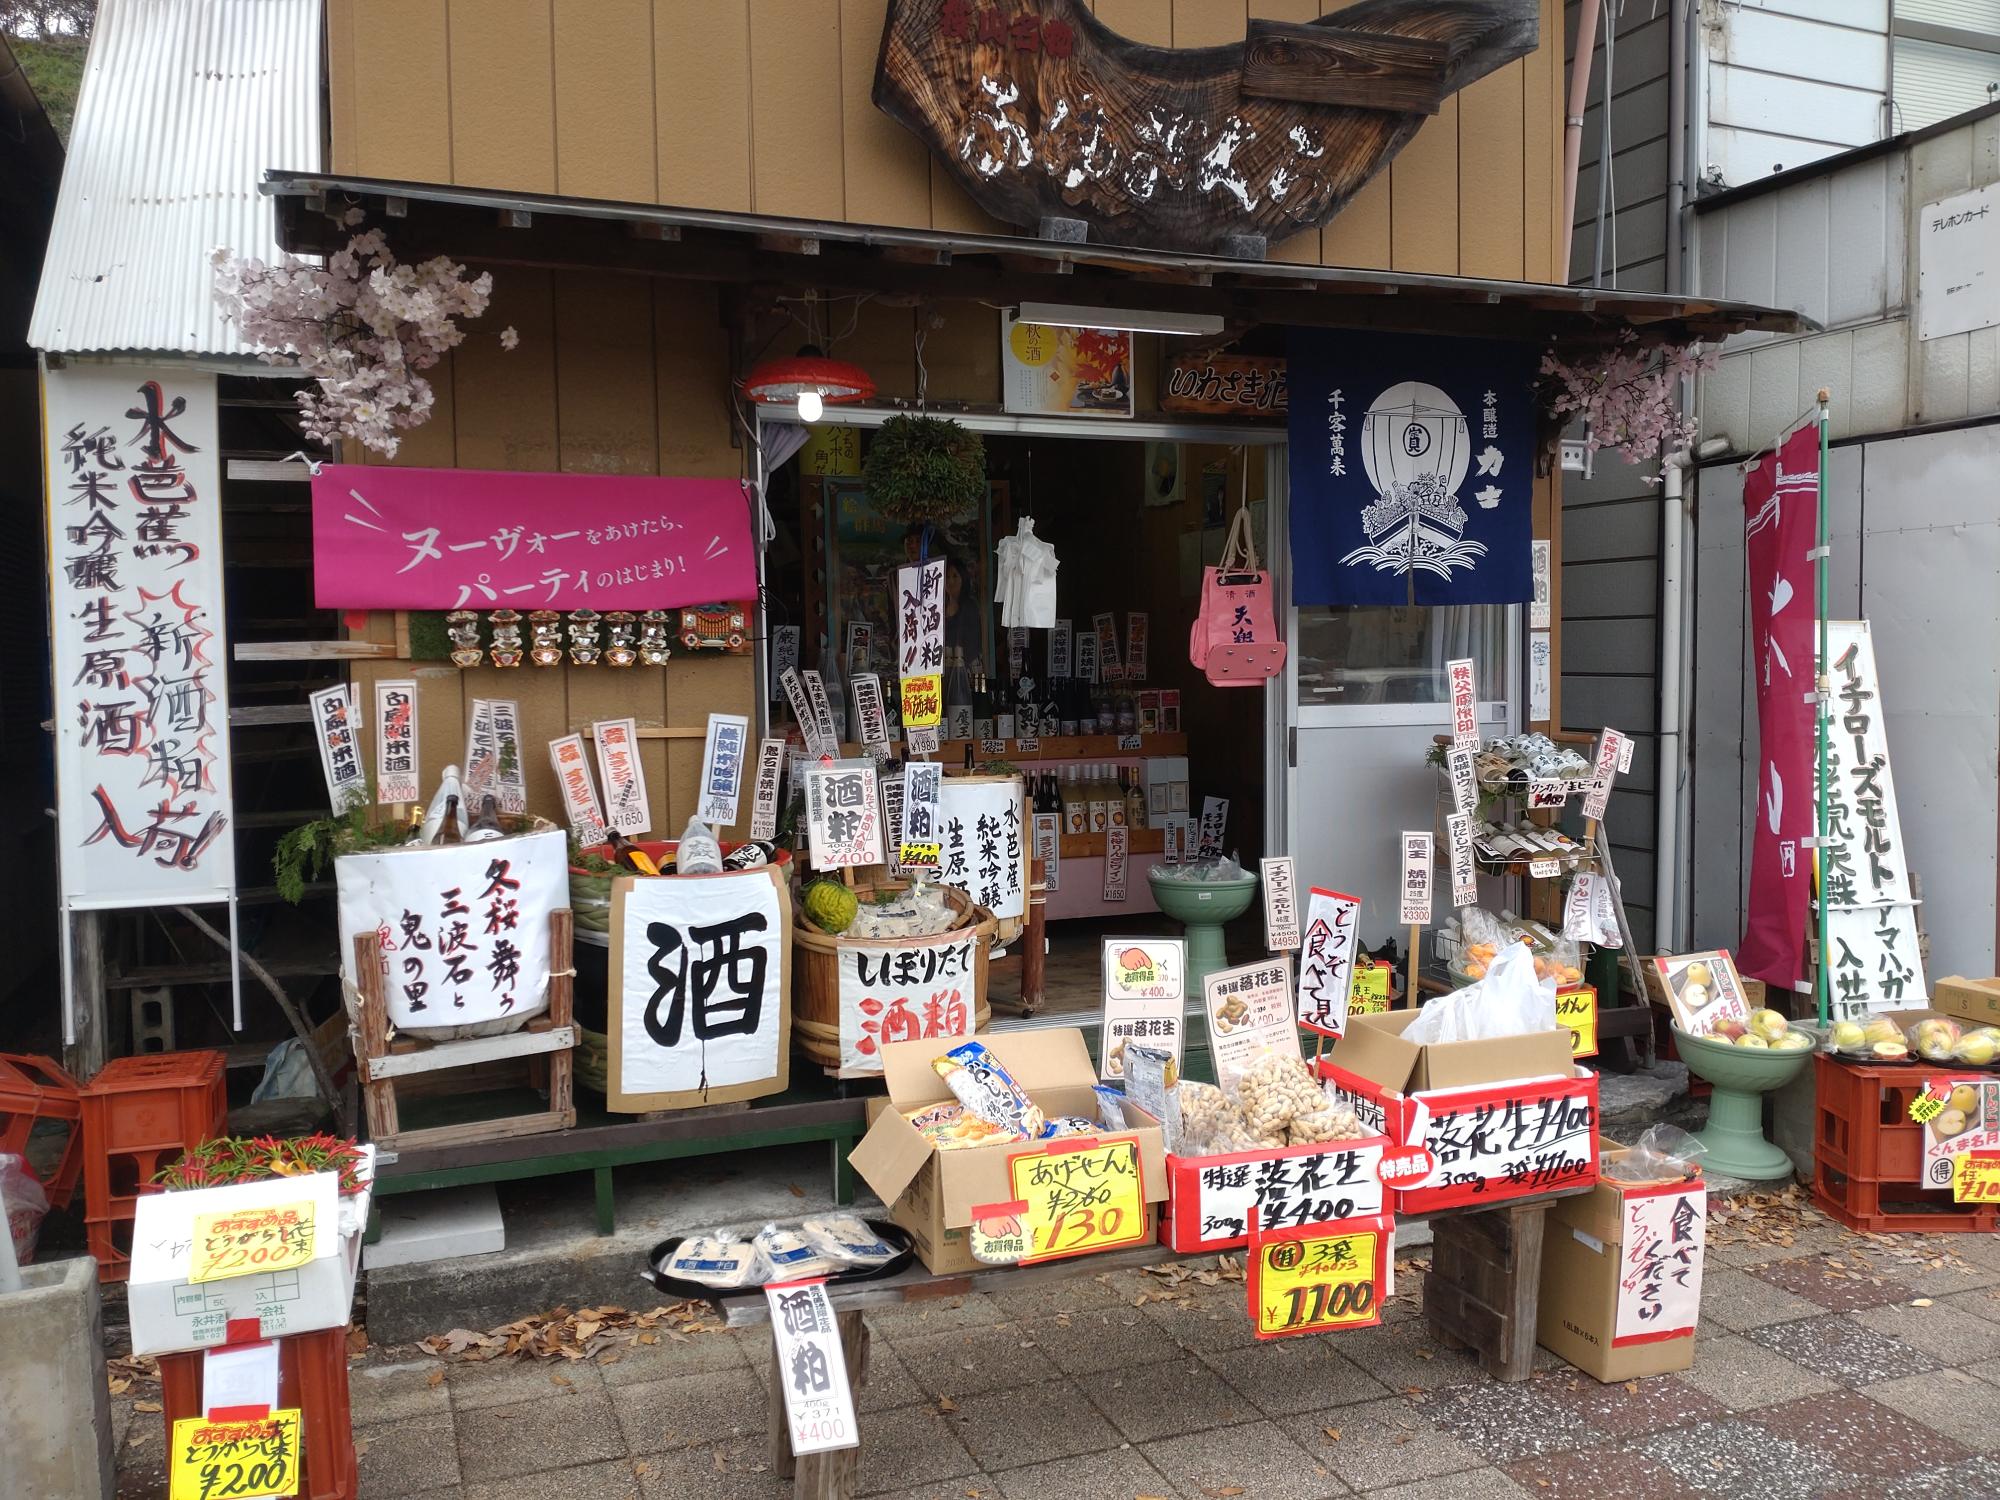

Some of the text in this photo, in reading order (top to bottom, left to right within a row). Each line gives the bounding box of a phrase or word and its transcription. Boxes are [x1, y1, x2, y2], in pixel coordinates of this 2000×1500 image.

[1932, 204, 1990, 232] テレホンカード
[1024, 323, 1042, 361] 秋の酒
[1474, 389, 1505, 509] 本醸造 力士
[127, 380, 201, 571] 水芭蕉
[396, 517, 683, 574] ヌーヴォーをあけたら、
[61, 421, 146, 755] 純米吟醸生原酒
[920, 566, 944, 669] 新酒粕
[140, 611, 208, 793] 新酒粕
[911, 741, 937, 753] ¥1980
[758, 745, 779, 802] 鬼石麦焼酎
[863, 769, 875, 810] しぼりたて
[379, 786, 417, 802] ¥3300
[824, 773, 864, 844] 酒粕
[909, 769, 932, 839] 酒粕
[612, 811, 644, 827] ¥1650
[752, 827, 775, 840] ¥1760
[823, 852, 875, 865] ¥400
[901, 849, 938, 866] ¥400
[976, 813, 1003, 909] 純米吟醸
[1003, 798, 1021, 896] 水芭蕉
[1408, 839, 1428, 859] 魔王
[1105, 889, 1125, 900] ¥1650
[1408, 869, 1428, 889] 焼酎
[1402, 911, 1430, 921] ¥3300
[1454, 891, 1478, 906] ¥1650
[438, 887, 478, 1008] 三波石と
[477, 858, 523, 1015] 冬桜舞う
[1270, 930, 1298, 938] ¥4500
[1271, 937, 1299, 947] ¥4950
[1326, 902, 1358, 979] どうぞ
[400, 909, 432, 1013] 鬼の里
[856, 943, 972, 987] しぼりたて
[643, 911, 768, 1048] 酒
[1140, 985, 1165, 998] ¥400
[1216, 969, 1286, 997] 特選落花生
[854, 988, 968, 1056] 酒粕
[1112, 1019, 1176, 1037] 特選落花生
[1426, 1100, 1530, 1166] 落花生
[1927, 1131, 1999, 1157] ぐんま名月
[1028, 1146, 1138, 1187] あげせん!
[1379, 1153, 1430, 1180] 特売品
[1934, 1161, 1951, 1181] 得
[213, 1210, 298, 1234] おすすめ品
[1200, 1216, 1246, 1239] 300g
[983, 1239, 1024, 1253] お買得品
[1669, 1196, 1701, 1288] 食べて
[202, 1245, 289, 1278] ¥200
[1638, 1239, 1671, 1320] ください
[776, 1290, 831, 1396] 酒粕
[794, 1407, 840, 1420] ¥371
[796, 1418, 845, 1443] ¥400
[200, 1462, 287, 1500] ¥200
